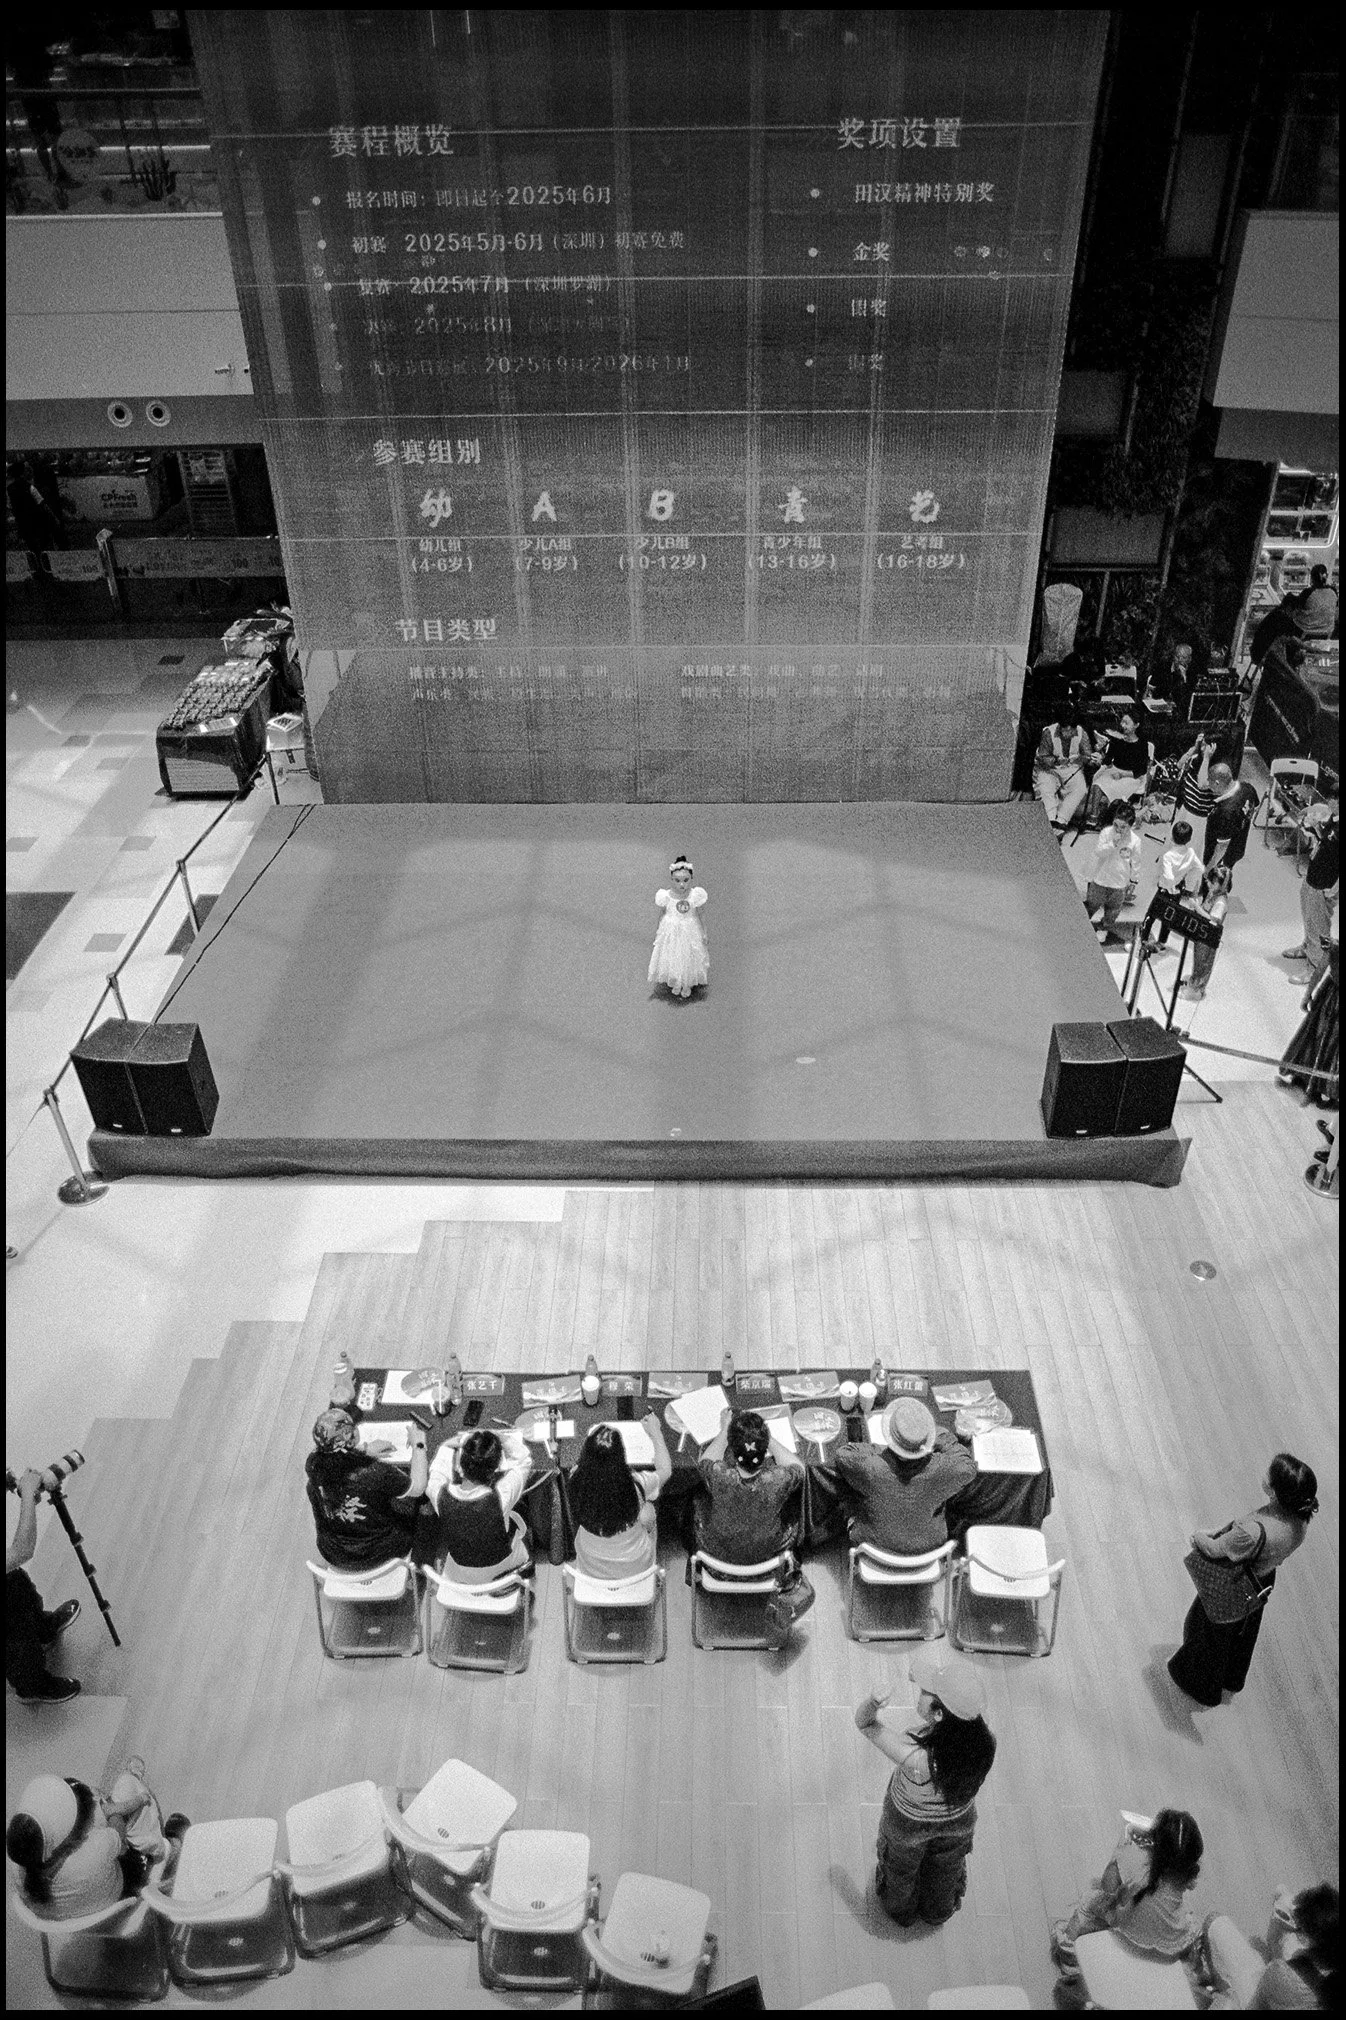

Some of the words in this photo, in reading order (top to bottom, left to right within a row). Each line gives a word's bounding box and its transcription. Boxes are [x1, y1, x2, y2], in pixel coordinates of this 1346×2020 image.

[328, 124, 454, 158] 赛程概览
[837, 117, 961, 149] 奖项设置
[854, 182, 995, 203] 田汉精神特别奖
[853, 242, 890, 261] 金奖
[373, 439, 481, 466] 参赛组别
[419, 488, 453, 528] 幼
[531, 491, 557, 521] A
[649, 489, 675, 521] B
[419, 538, 461, 552] 幼儿组
[518, 537, 572, 551] 少儿A组
[636, 536, 689, 550] 少儿B组
[763, 536, 822, 550] 青少年组
[901, 535, 944, 550] 艺考组
[396, 618, 498, 642] 节目类型
